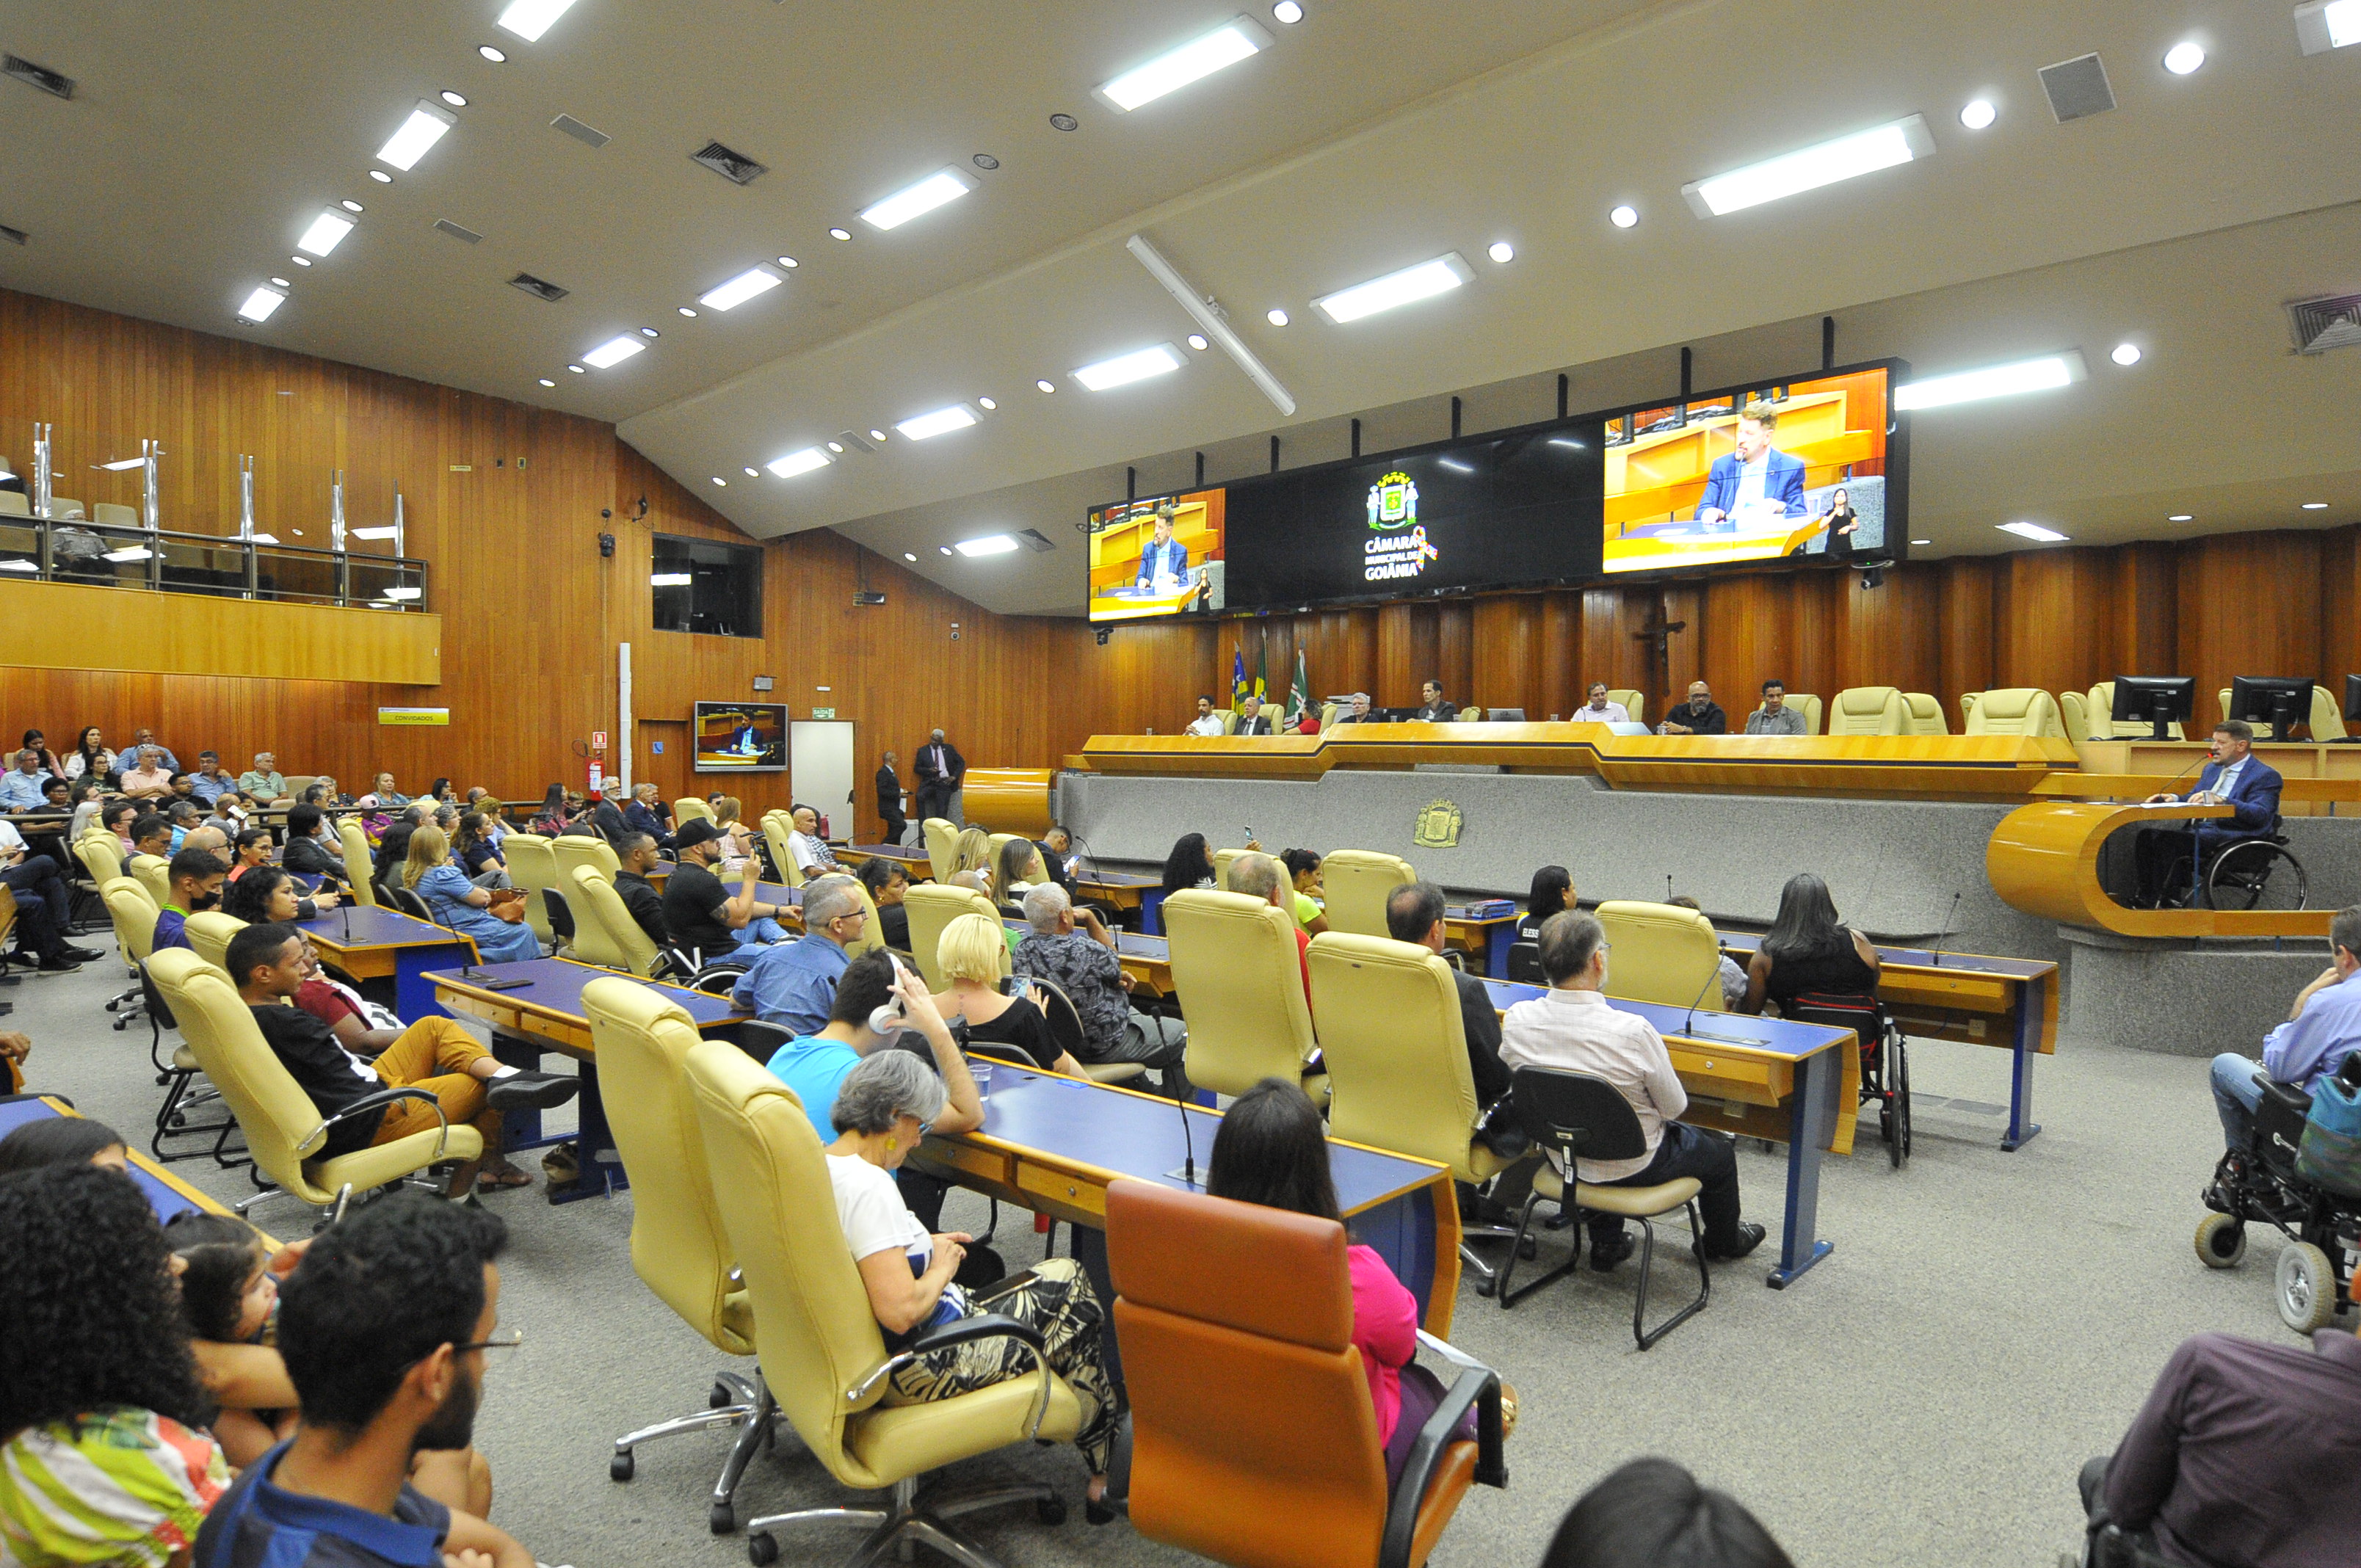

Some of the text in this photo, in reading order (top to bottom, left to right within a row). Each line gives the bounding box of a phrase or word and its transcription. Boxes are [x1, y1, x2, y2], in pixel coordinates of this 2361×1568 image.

[1366, 536, 1418, 553] CÂMARA
[1366, 551, 1418, 565] MUNICIPAL DE
[1366, 562, 1418, 581] GOIÂNIA
